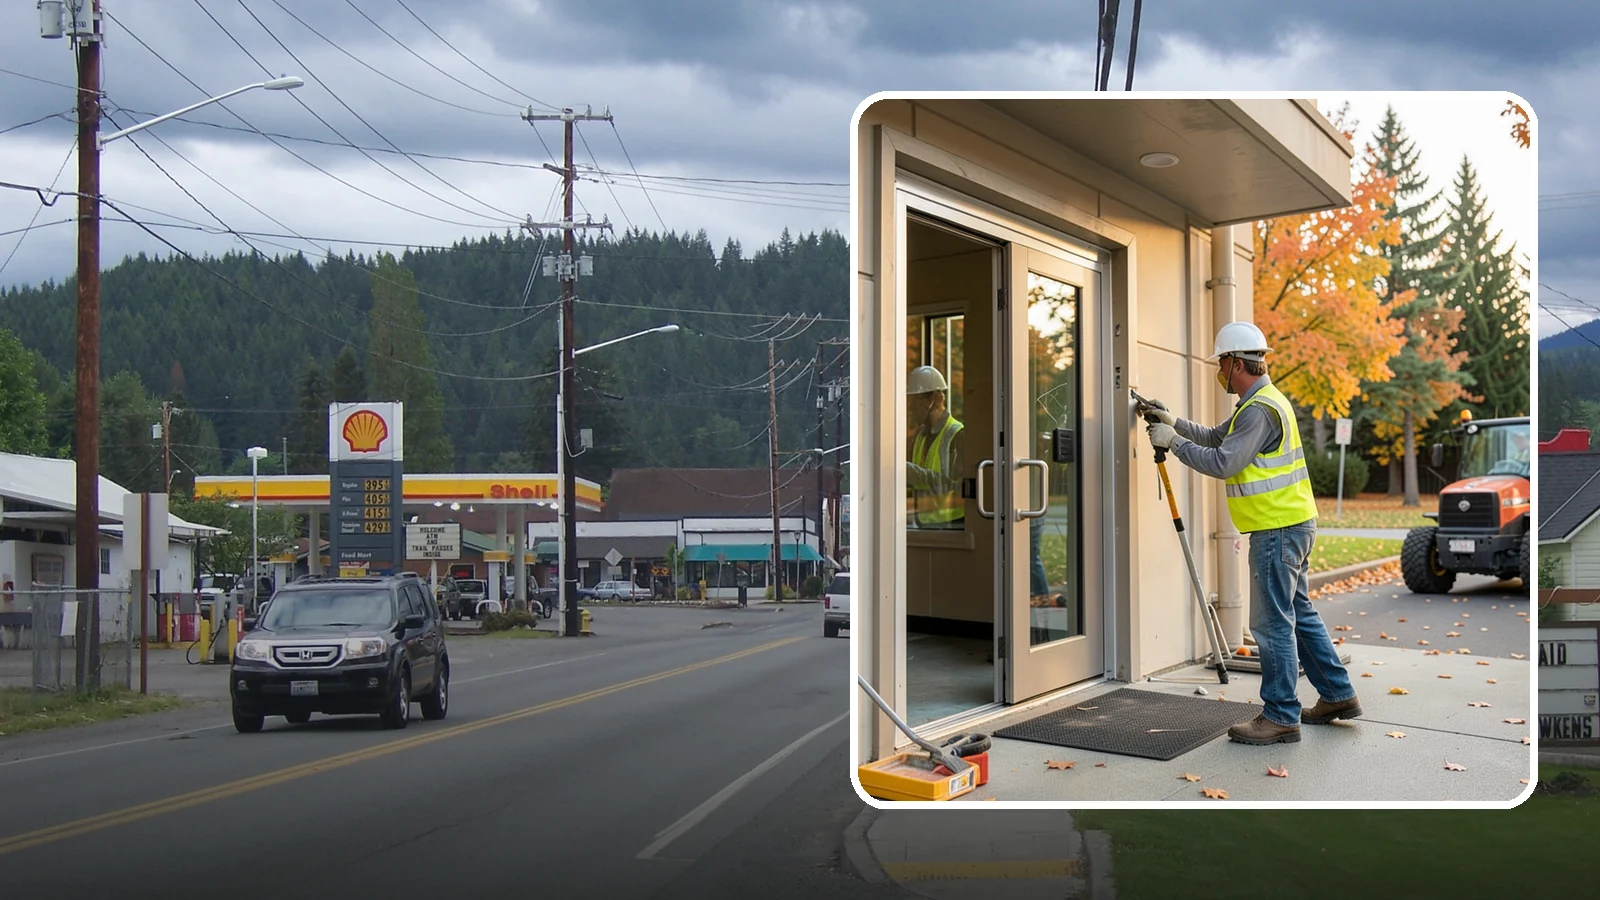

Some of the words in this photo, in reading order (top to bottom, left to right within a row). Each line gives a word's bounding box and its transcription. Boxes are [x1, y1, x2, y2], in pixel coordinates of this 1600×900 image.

[366, 480, 383, 490] 395
[490, 484, 547, 499] Shell
[365, 494, 383, 504] 405
[365, 508, 383, 518] 415
[366, 522, 383, 533] 429
